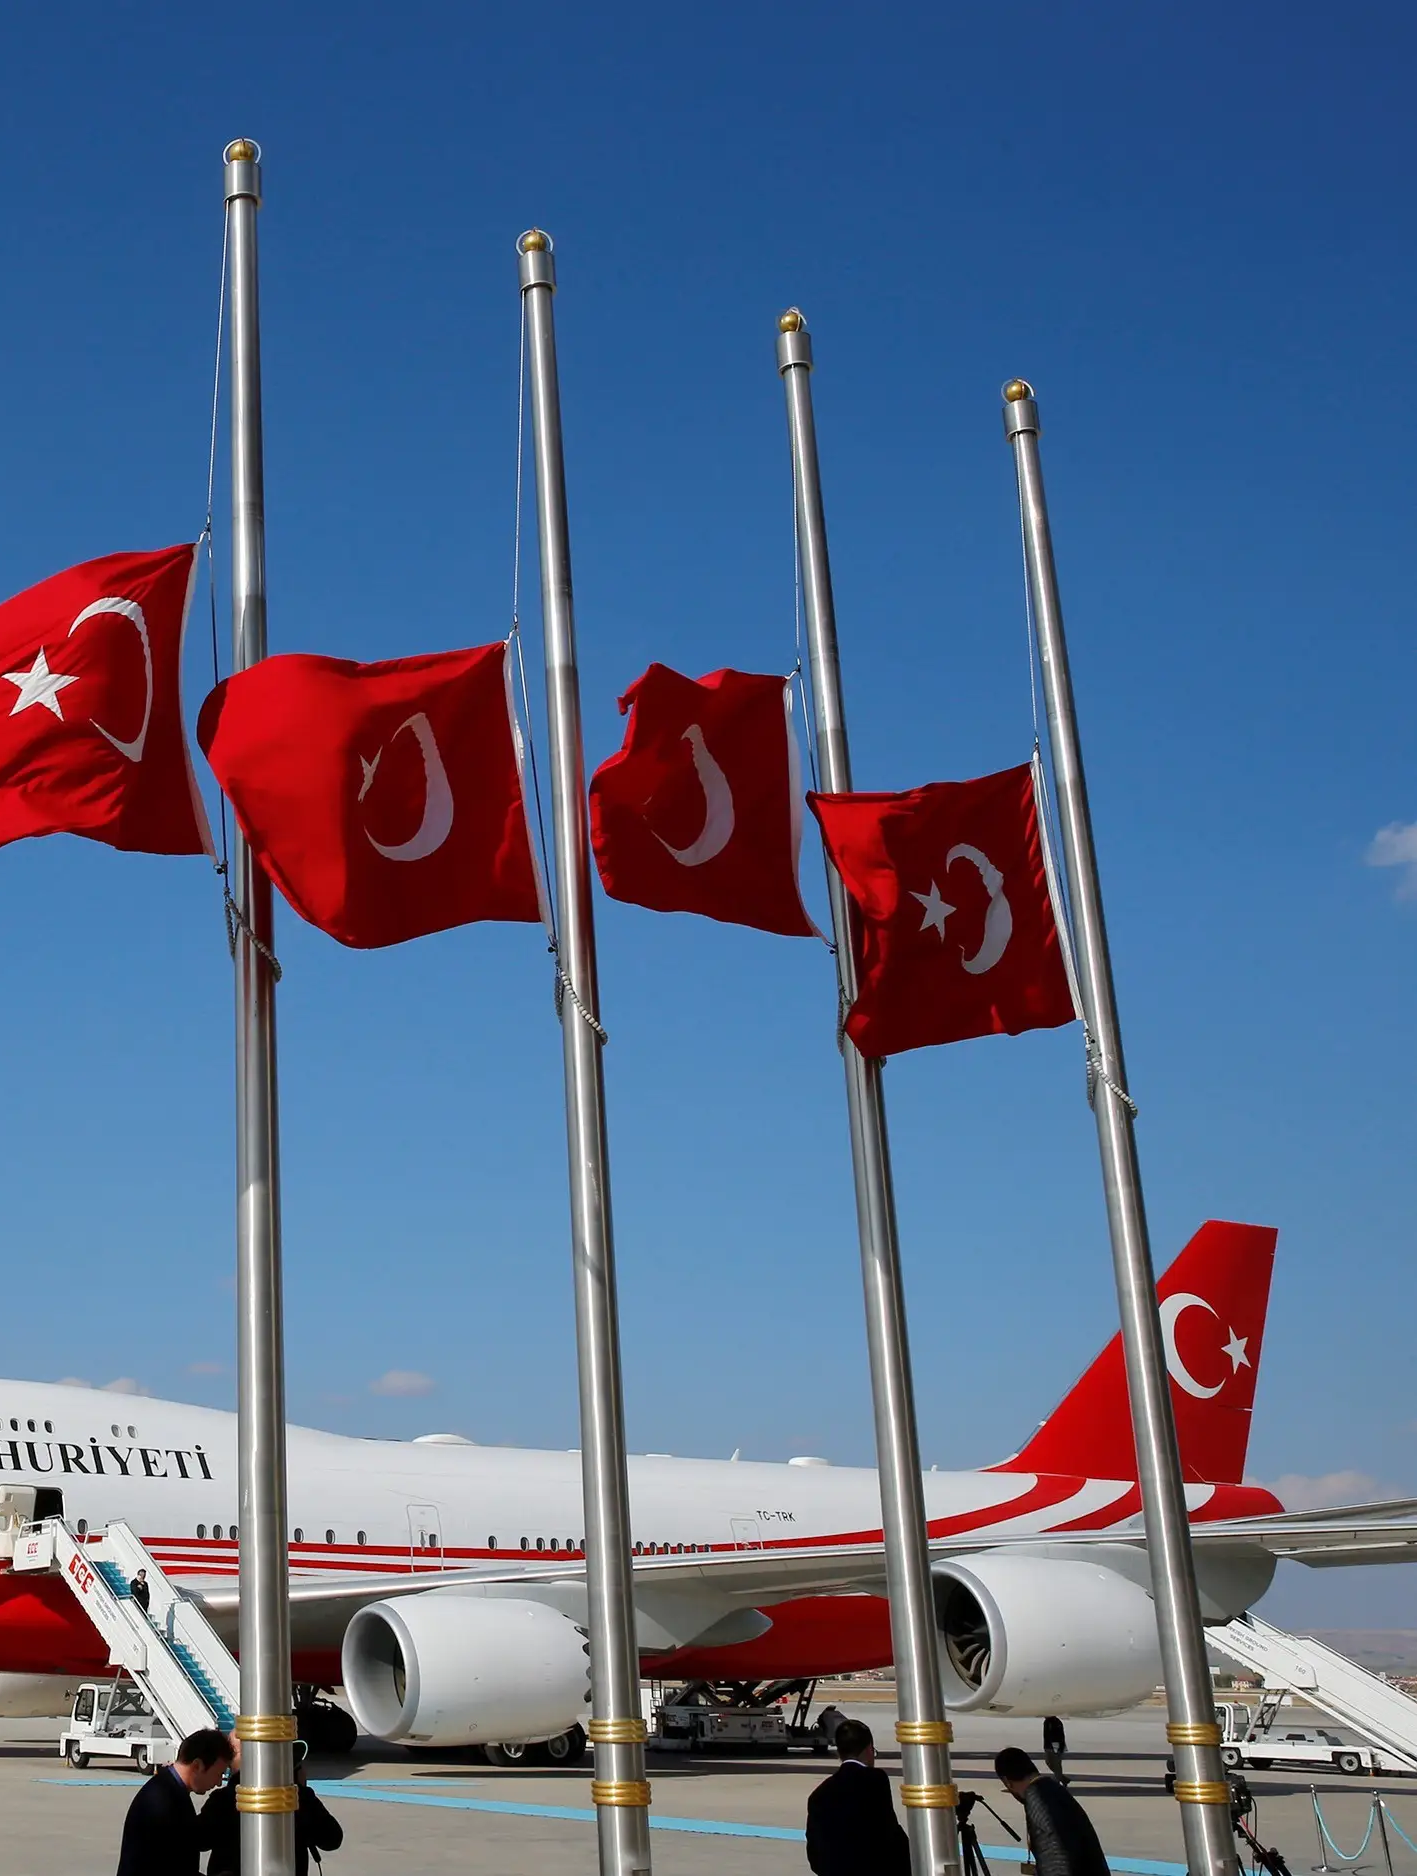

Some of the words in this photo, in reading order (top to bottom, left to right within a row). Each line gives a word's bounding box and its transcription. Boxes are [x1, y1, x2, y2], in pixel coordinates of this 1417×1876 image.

[756, 1510, 796, 1522] TC-TRK
[68, 1553, 95, 1594] TGS
[1229, 1634, 1255, 1651] SERVICES
